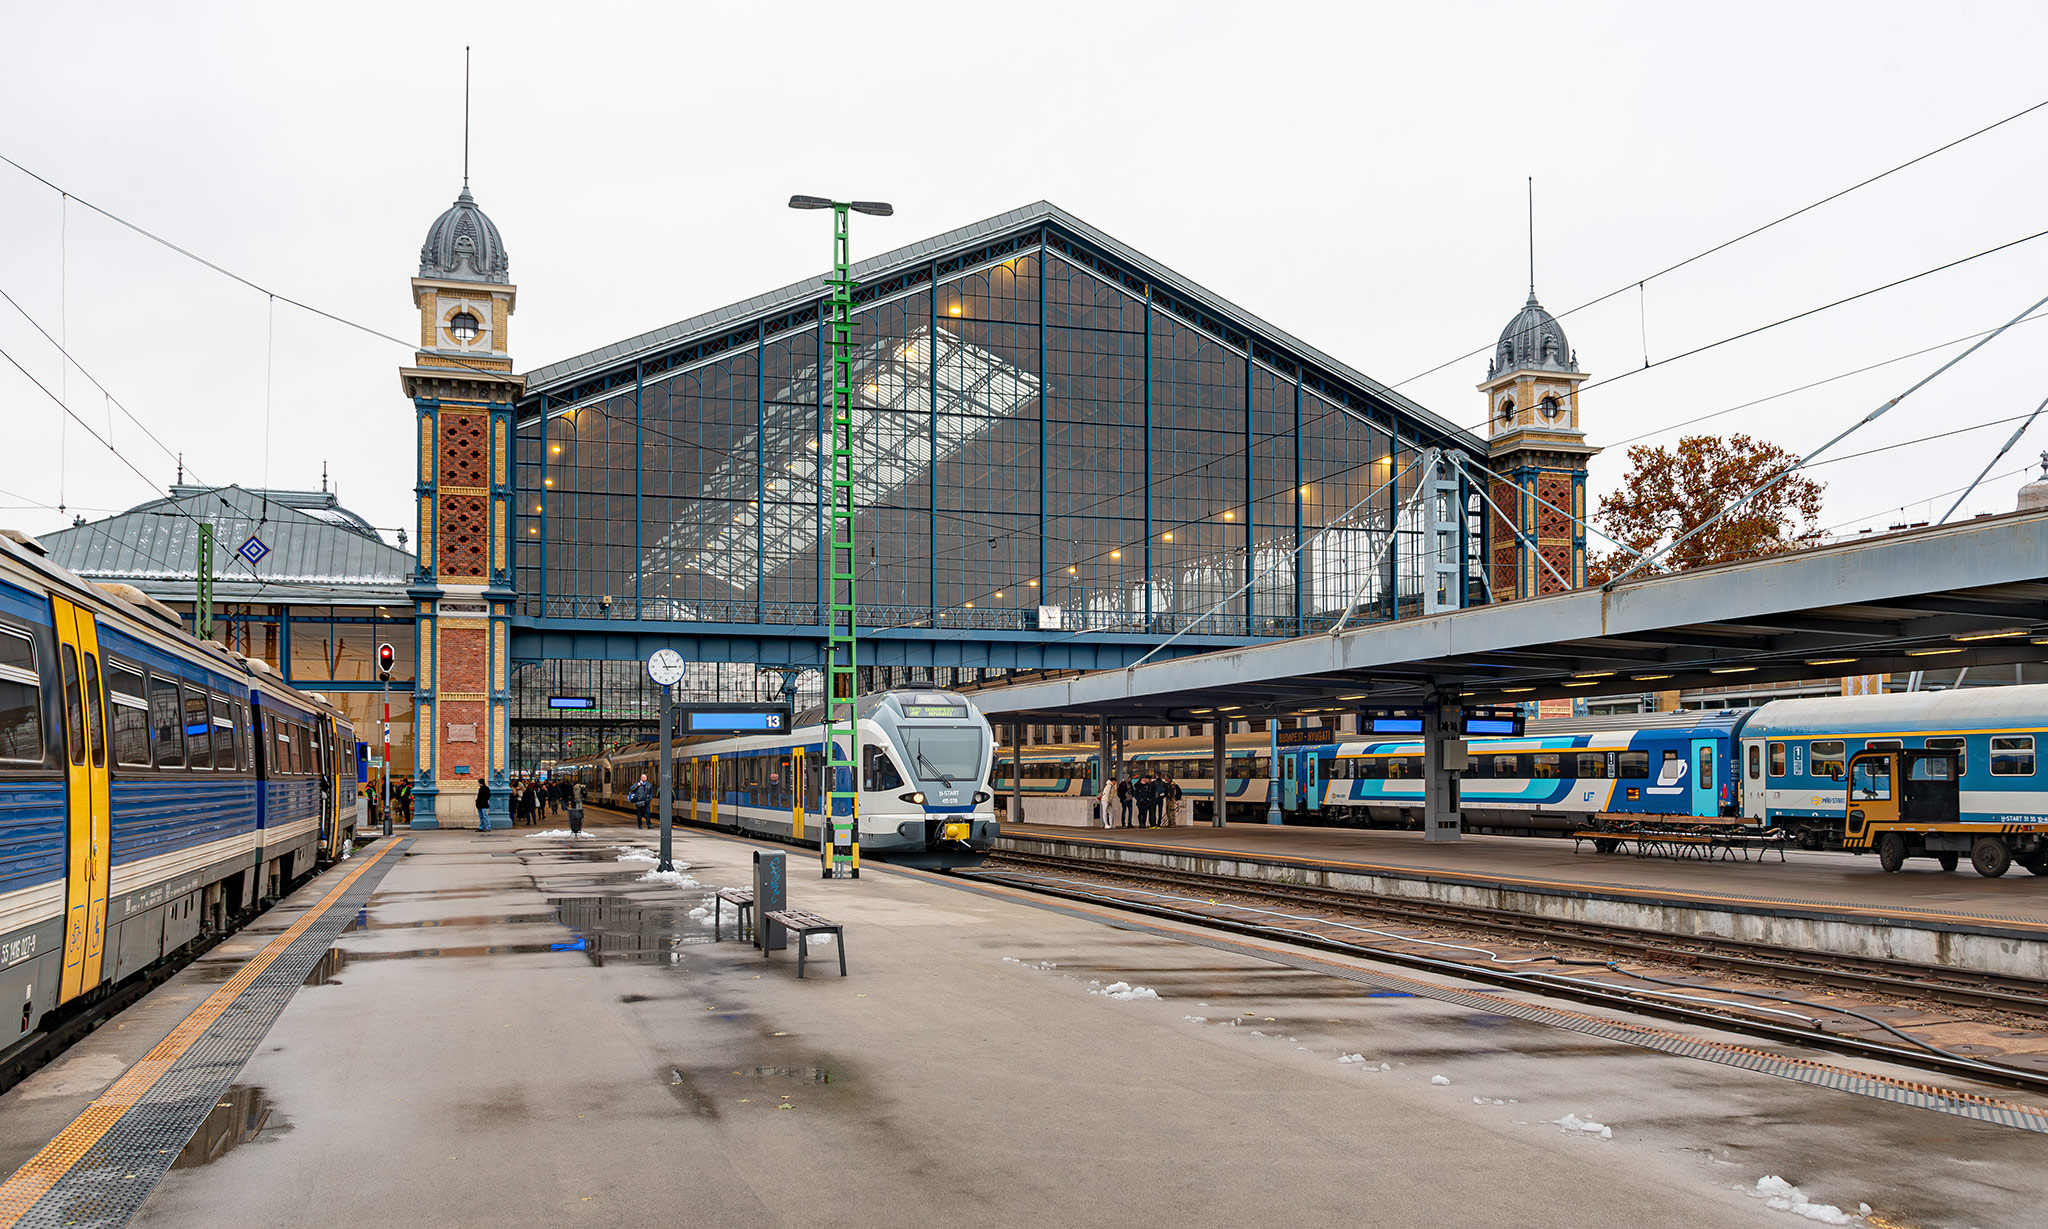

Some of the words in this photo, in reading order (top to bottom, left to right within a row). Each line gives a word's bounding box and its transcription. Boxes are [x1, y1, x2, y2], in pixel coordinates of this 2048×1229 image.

[766, 715, 780, 728] 13
[1365, 722, 1374, 730] 12
[1278, 731, 1304, 744] BUDAPEST
[1307, 730, 1331, 742] NYUGATI
[1, 943, 10, 964] 55
